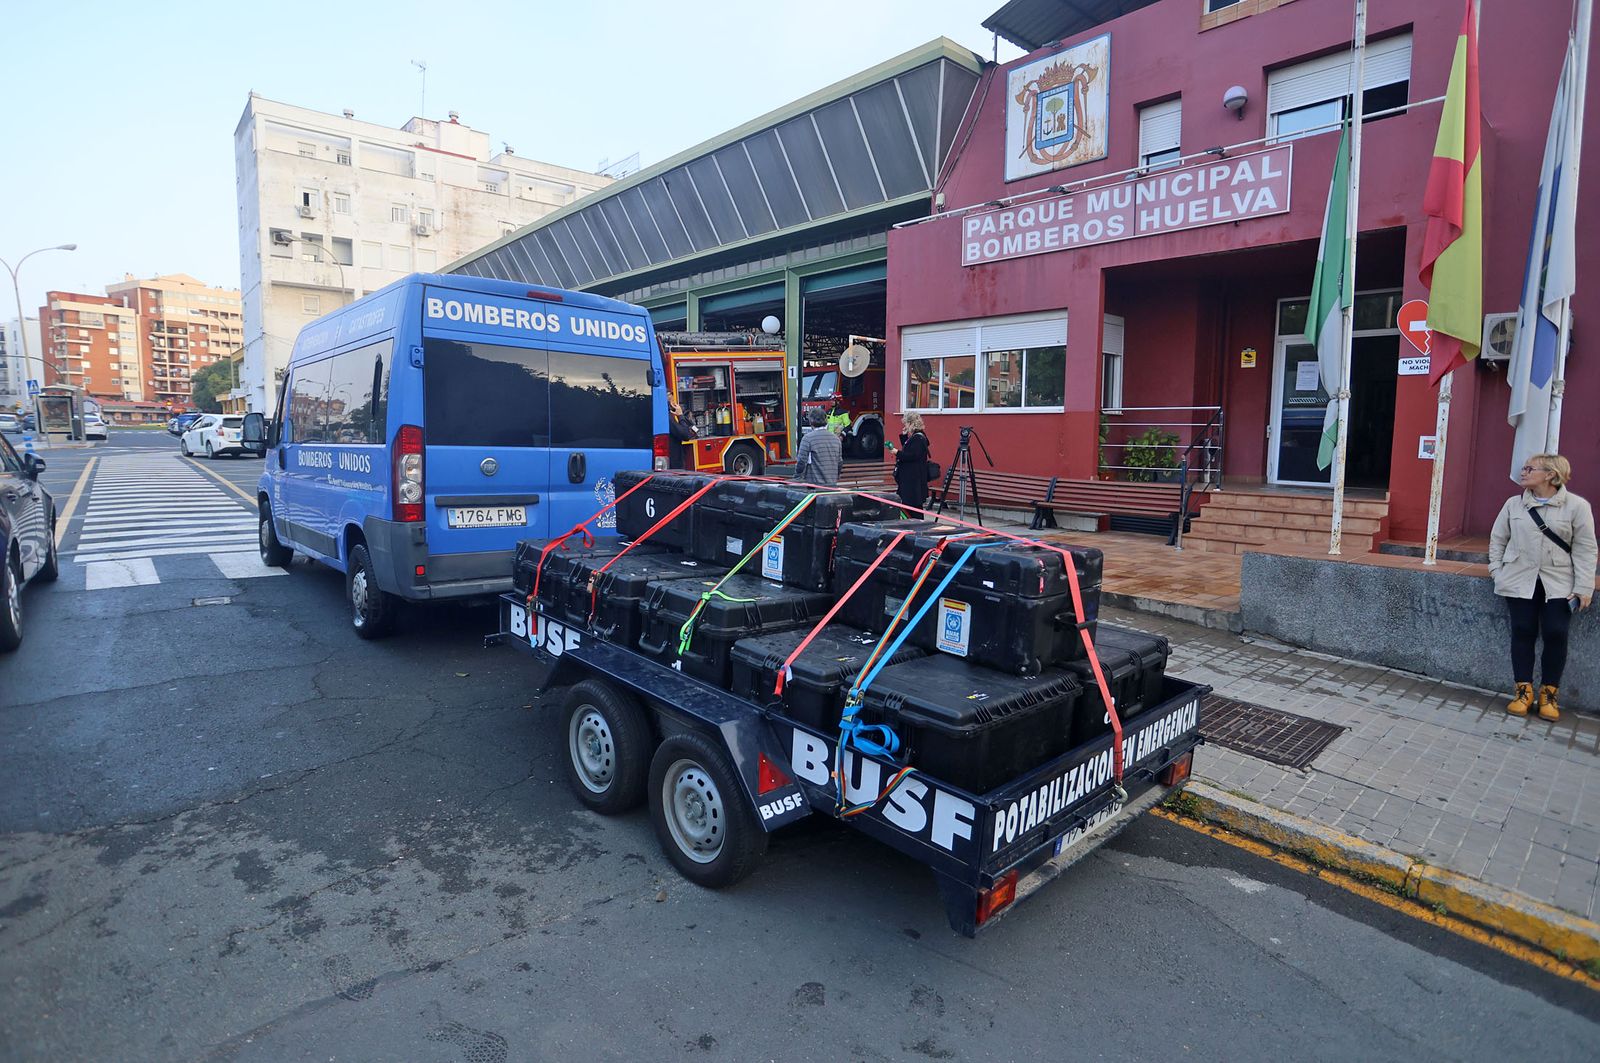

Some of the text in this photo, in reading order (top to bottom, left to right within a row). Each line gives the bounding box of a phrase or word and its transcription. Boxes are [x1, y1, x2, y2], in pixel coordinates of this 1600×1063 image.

[966, 155, 1282, 239] PARQUE MUNICIPAL
[966, 186, 1278, 261] BOMBEROS HUELVA
[427, 298, 647, 343] BOMBEROS UNIDOS
[298, 450, 371, 473] BOMBEROS UNIDOS
[459, 509, 522, 523] 1764 FMG
[645, 497, 656, 518] 6
[1136, 699, 1198, 762] EMERGENCIA
[759, 792, 803, 821] BUSF
[791, 727, 976, 851] BUSF
